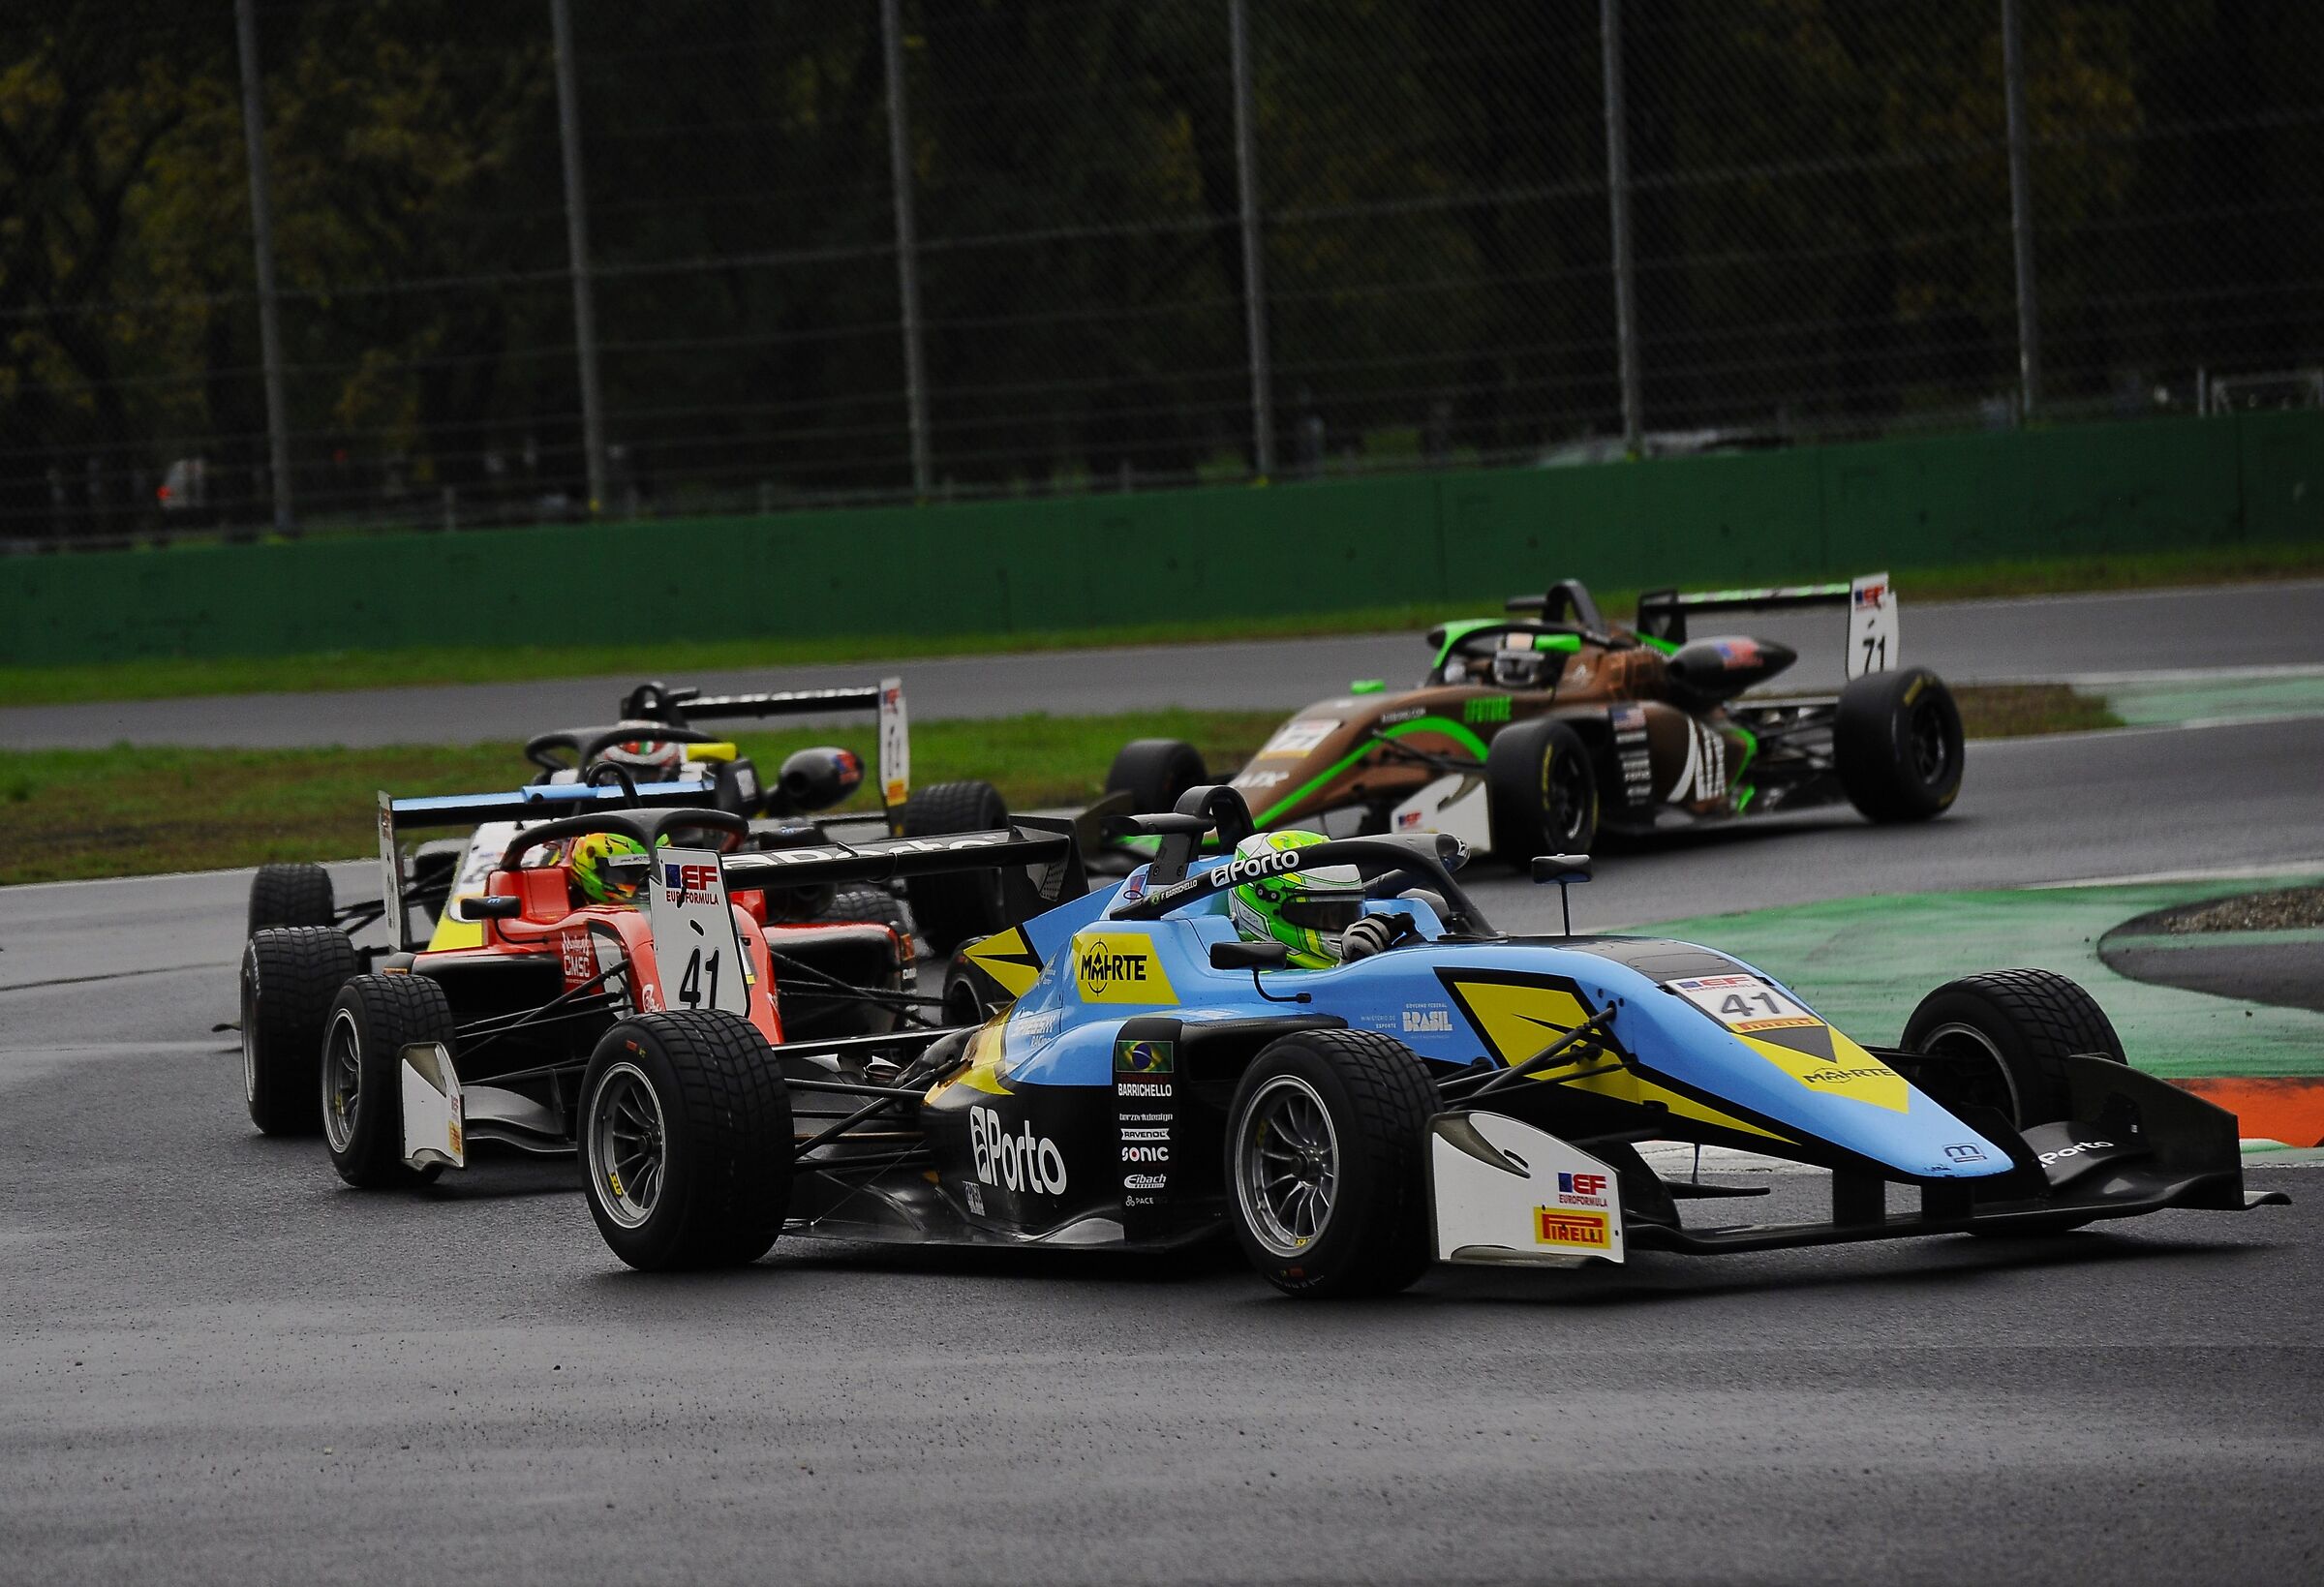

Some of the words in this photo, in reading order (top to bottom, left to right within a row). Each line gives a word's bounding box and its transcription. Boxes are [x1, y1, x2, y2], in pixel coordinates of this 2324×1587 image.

[1863, 634, 1885, 673] 71
[1230, 850, 1300, 881] Porto
[682, 865, 718, 891] EF
[666, 890, 719, 905] EURFORMULA
[679, 947, 719, 1010] 41
[1721, 992, 1781, 1017] 41
[1402, 1011, 1452, 1032] BRASIL
[1117, 1083, 1173, 1097] BARRICHELLO
[1123, 1130, 1167, 1139] RAVENOL
[987, 1109, 1067, 1195] Porto
[1123, 1174, 1167, 1189] Eibach
[1573, 1174, 1606, 1195] EF
[1559, 1194, 1608, 1207] EUROFORMULA
[1542, 1213, 1604, 1243] PIRELLI
